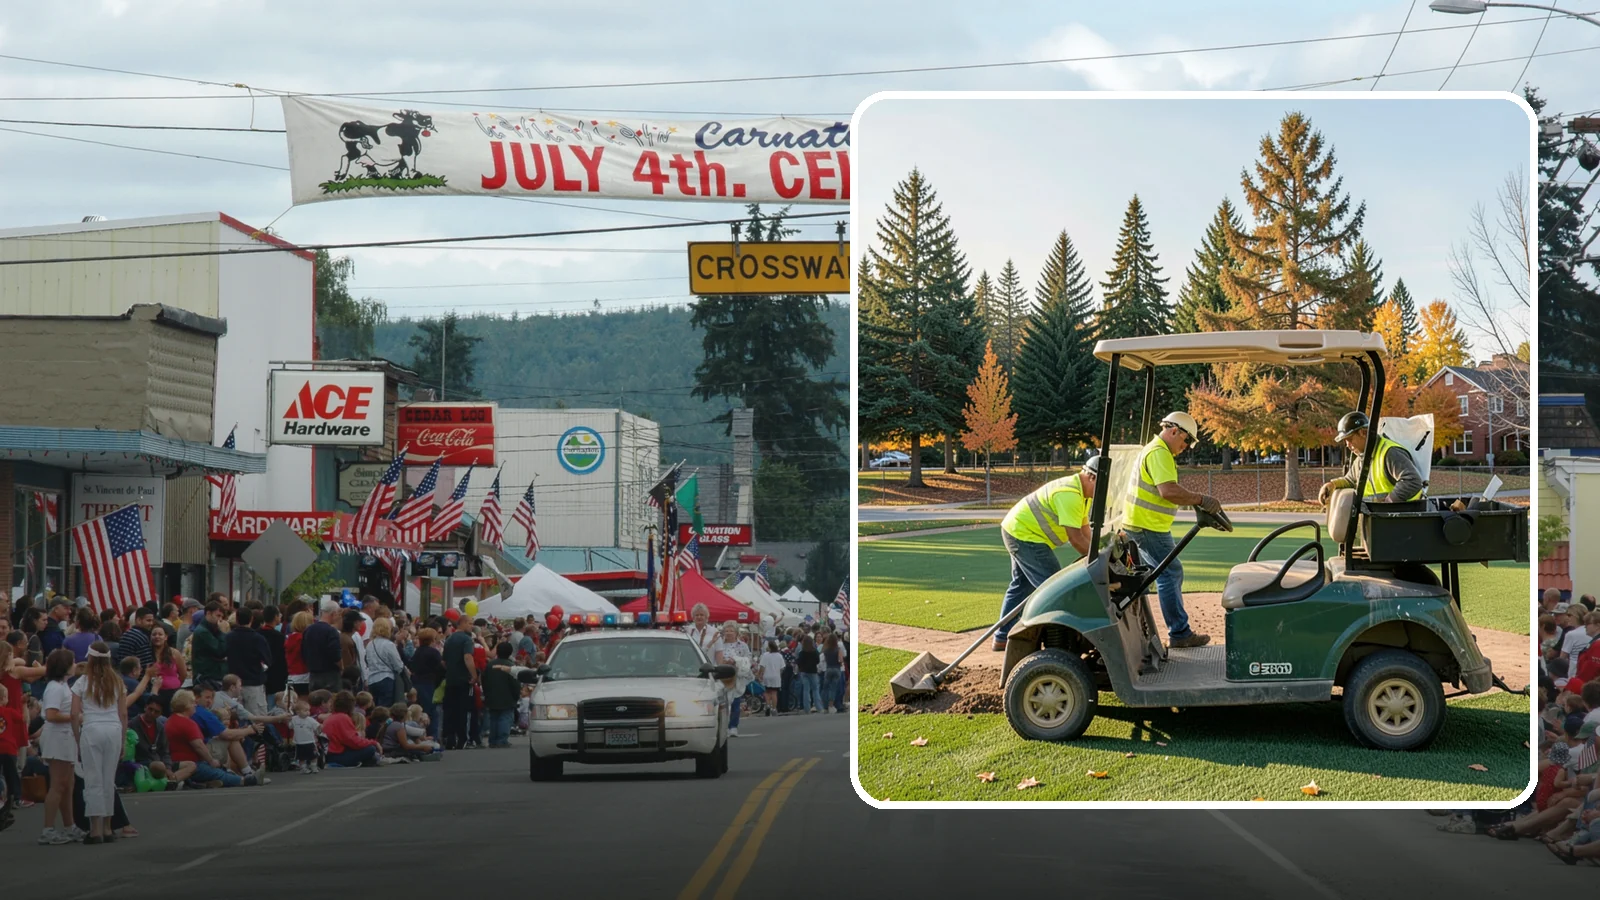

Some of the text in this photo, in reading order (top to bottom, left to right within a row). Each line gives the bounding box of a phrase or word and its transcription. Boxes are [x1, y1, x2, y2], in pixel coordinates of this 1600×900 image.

[481, 141, 605, 193] JULY
[632, 150, 746, 198] 4th.
[697, 254, 850, 280] CROSSWA
[283, 380, 373, 420] ACE
[405, 409, 485, 422] CEDAR LOG
[283, 421, 370, 436] Hardware
[83, 485, 155, 495] St. Vincent de Paul
[81, 503, 154, 522] THT
[213, 516, 331, 535] HARDARE
[688, 526, 741, 535] CRNATION
[699, 535, 730, 543] GLASS
